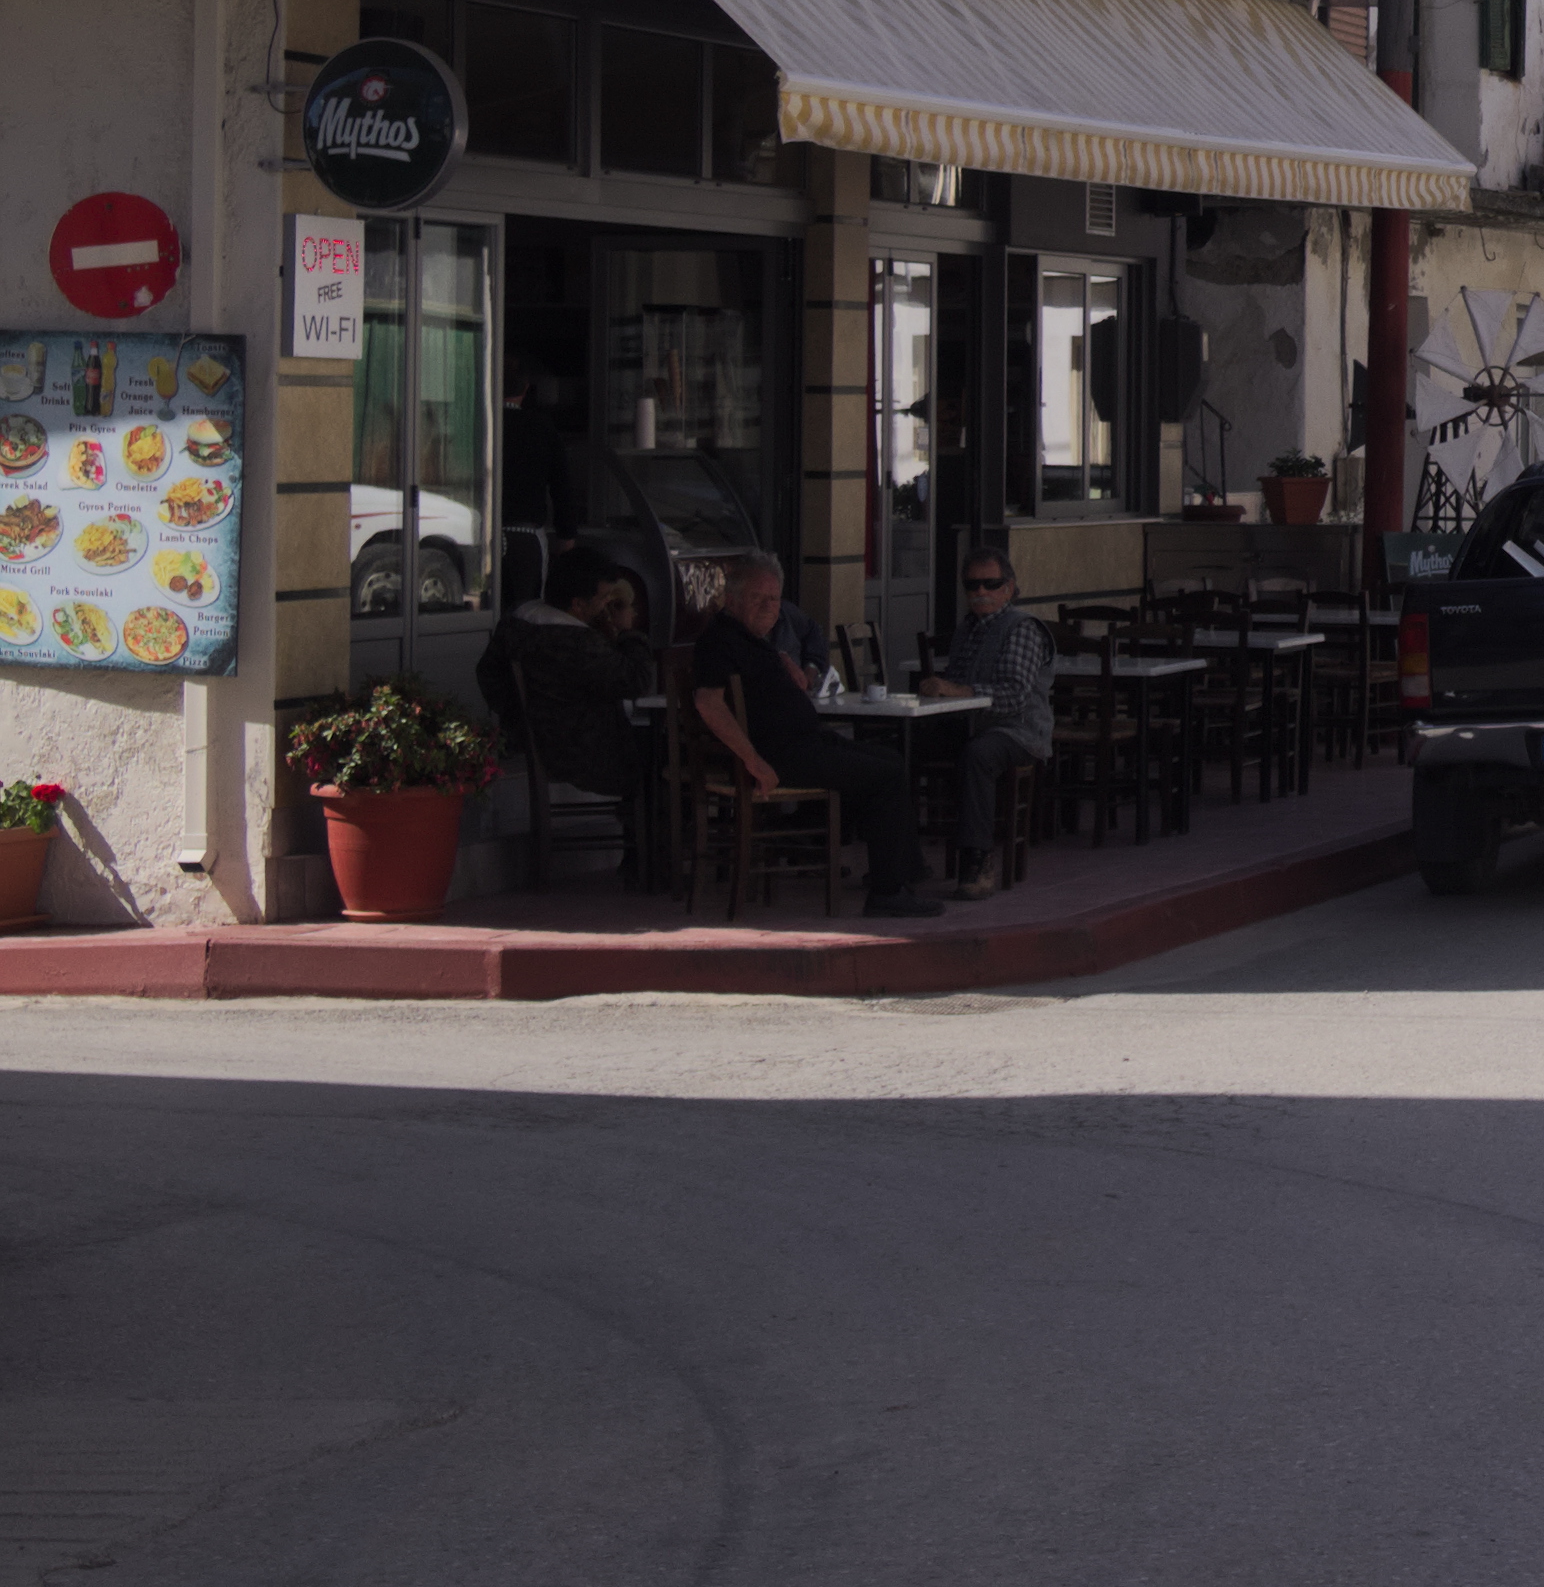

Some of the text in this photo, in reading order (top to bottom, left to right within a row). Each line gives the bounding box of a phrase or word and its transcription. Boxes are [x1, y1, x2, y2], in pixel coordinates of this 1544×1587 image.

[317, 97, 420, 160] Mythos
[302, 237, 359, 275] OPEN
[317, 281, 342, 303] FREE
[302, 315, 356, 344] WI-FI
[0, 350, 25, 360] offees
[52, 382, 71, 392] Soft
[129, 377, 155, 387] Fresh
[41, 396, 71, 406] Drinks
[120, 392, 154, 403] Orange
[128, 406, 154, 416] Juice
[182, 406, 235, 418] Hamburger
[69, 423, 117, 435] Pita Gyros
[0, 480, 48, 491] reek Salad
[115, 482, 158, 492] Omelette
[78, 502, 142, 513] Gyros Portion
[159, 533, 219, 545] Lamb Chops
[0, 565, 51, 576] Mixed Grill
[50, 586, 113, 597] Pork Souvlaki
[1440, 604, 1482, 614] TOYOTA
[197, 612, 230, 623] Burger
[193, 627, 229, 637] Portion
[17, 648, 56, 658] Souvlaki
[182, 657, 209, 667] Pizza
